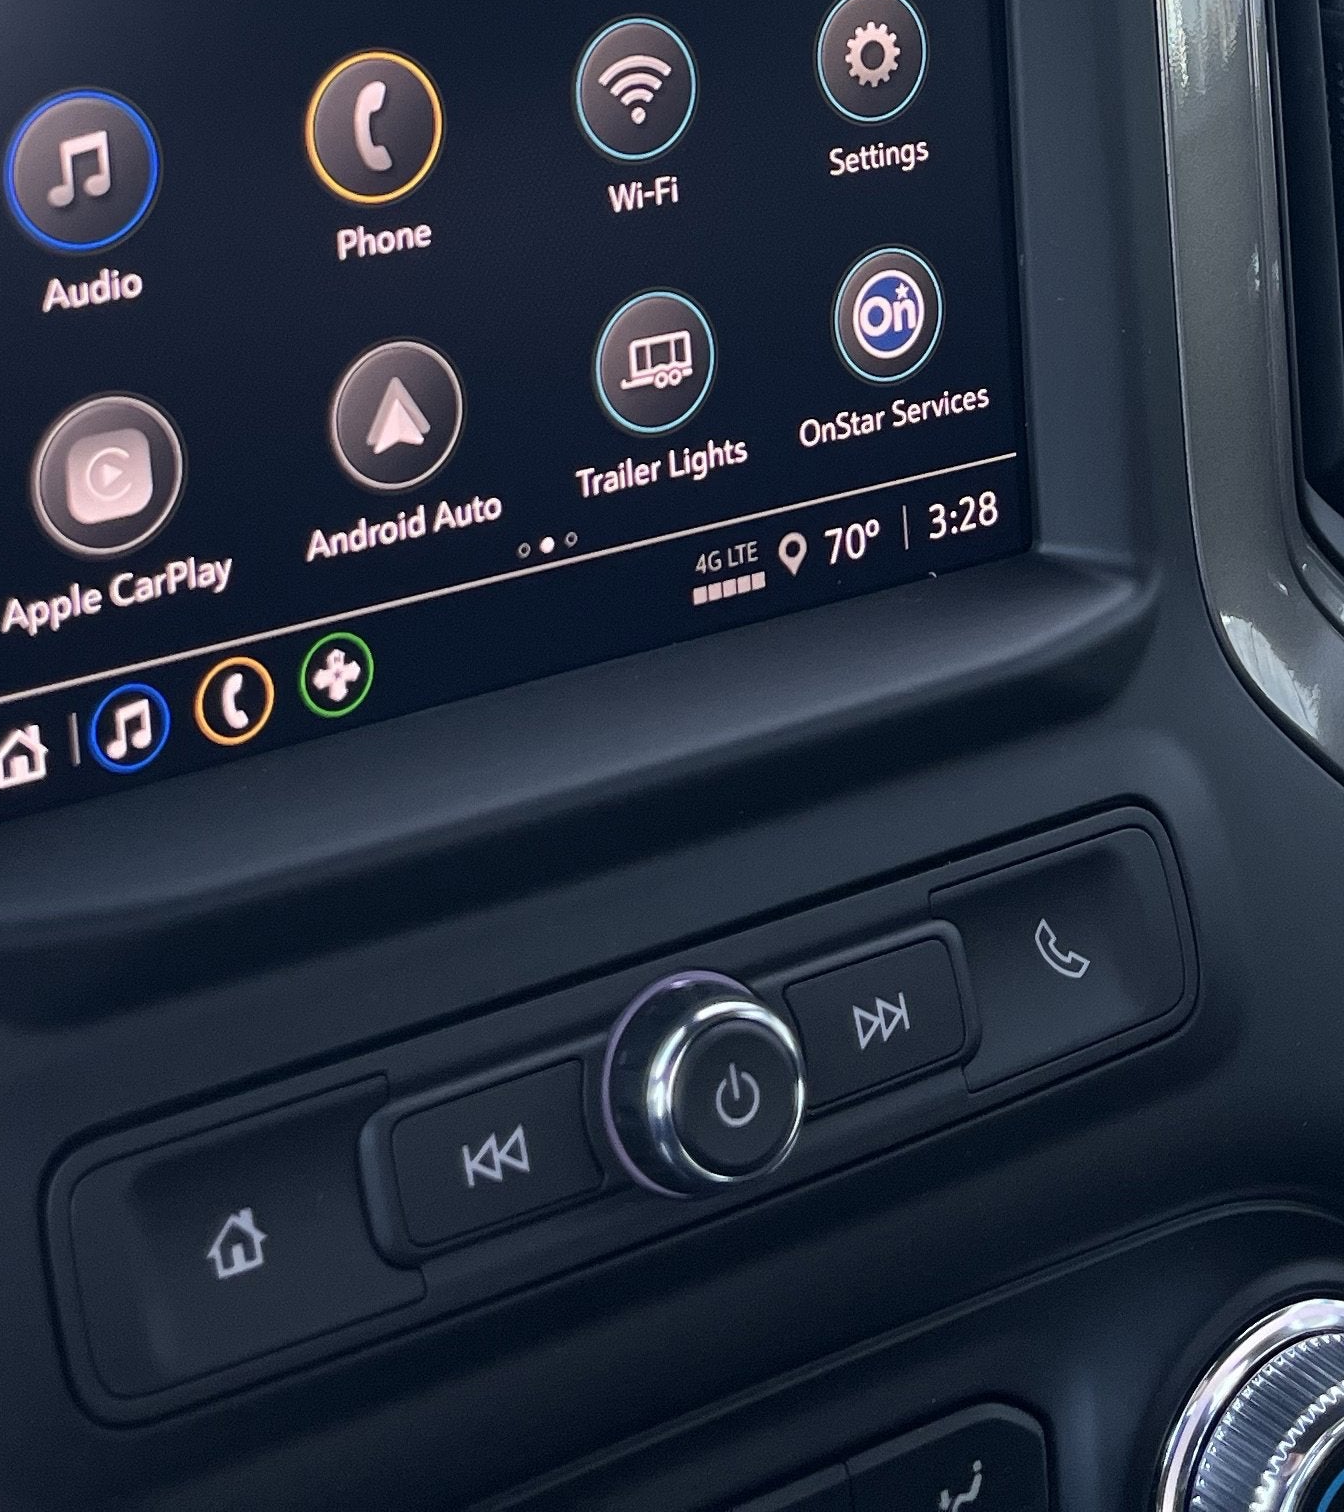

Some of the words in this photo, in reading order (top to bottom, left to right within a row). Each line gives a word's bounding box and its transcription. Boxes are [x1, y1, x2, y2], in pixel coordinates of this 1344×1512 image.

[829, 140, 930, 176] Settings
[608, 175, 679, 213] Wi-Fi
[336, 223, 433, 261] Phone
[42, 267, 144, 314] Audio
[798, 407, 885, 449] OnStar
[892, 388, 990, 428] Services
[576, 455, 662, 499] Trailer
[668, 439, 749, 482] Lights
[305, 506, 427, 563] Android
[433, 495, 503, 533] Auto
[928, 490, 999, 541] 3:28
[695, 549, 722, 576] 4G
[727, 541, 760, 567] LTE
[0, 583, 103, 636] Apple
[109, 556, 233, 608] CarPlay
